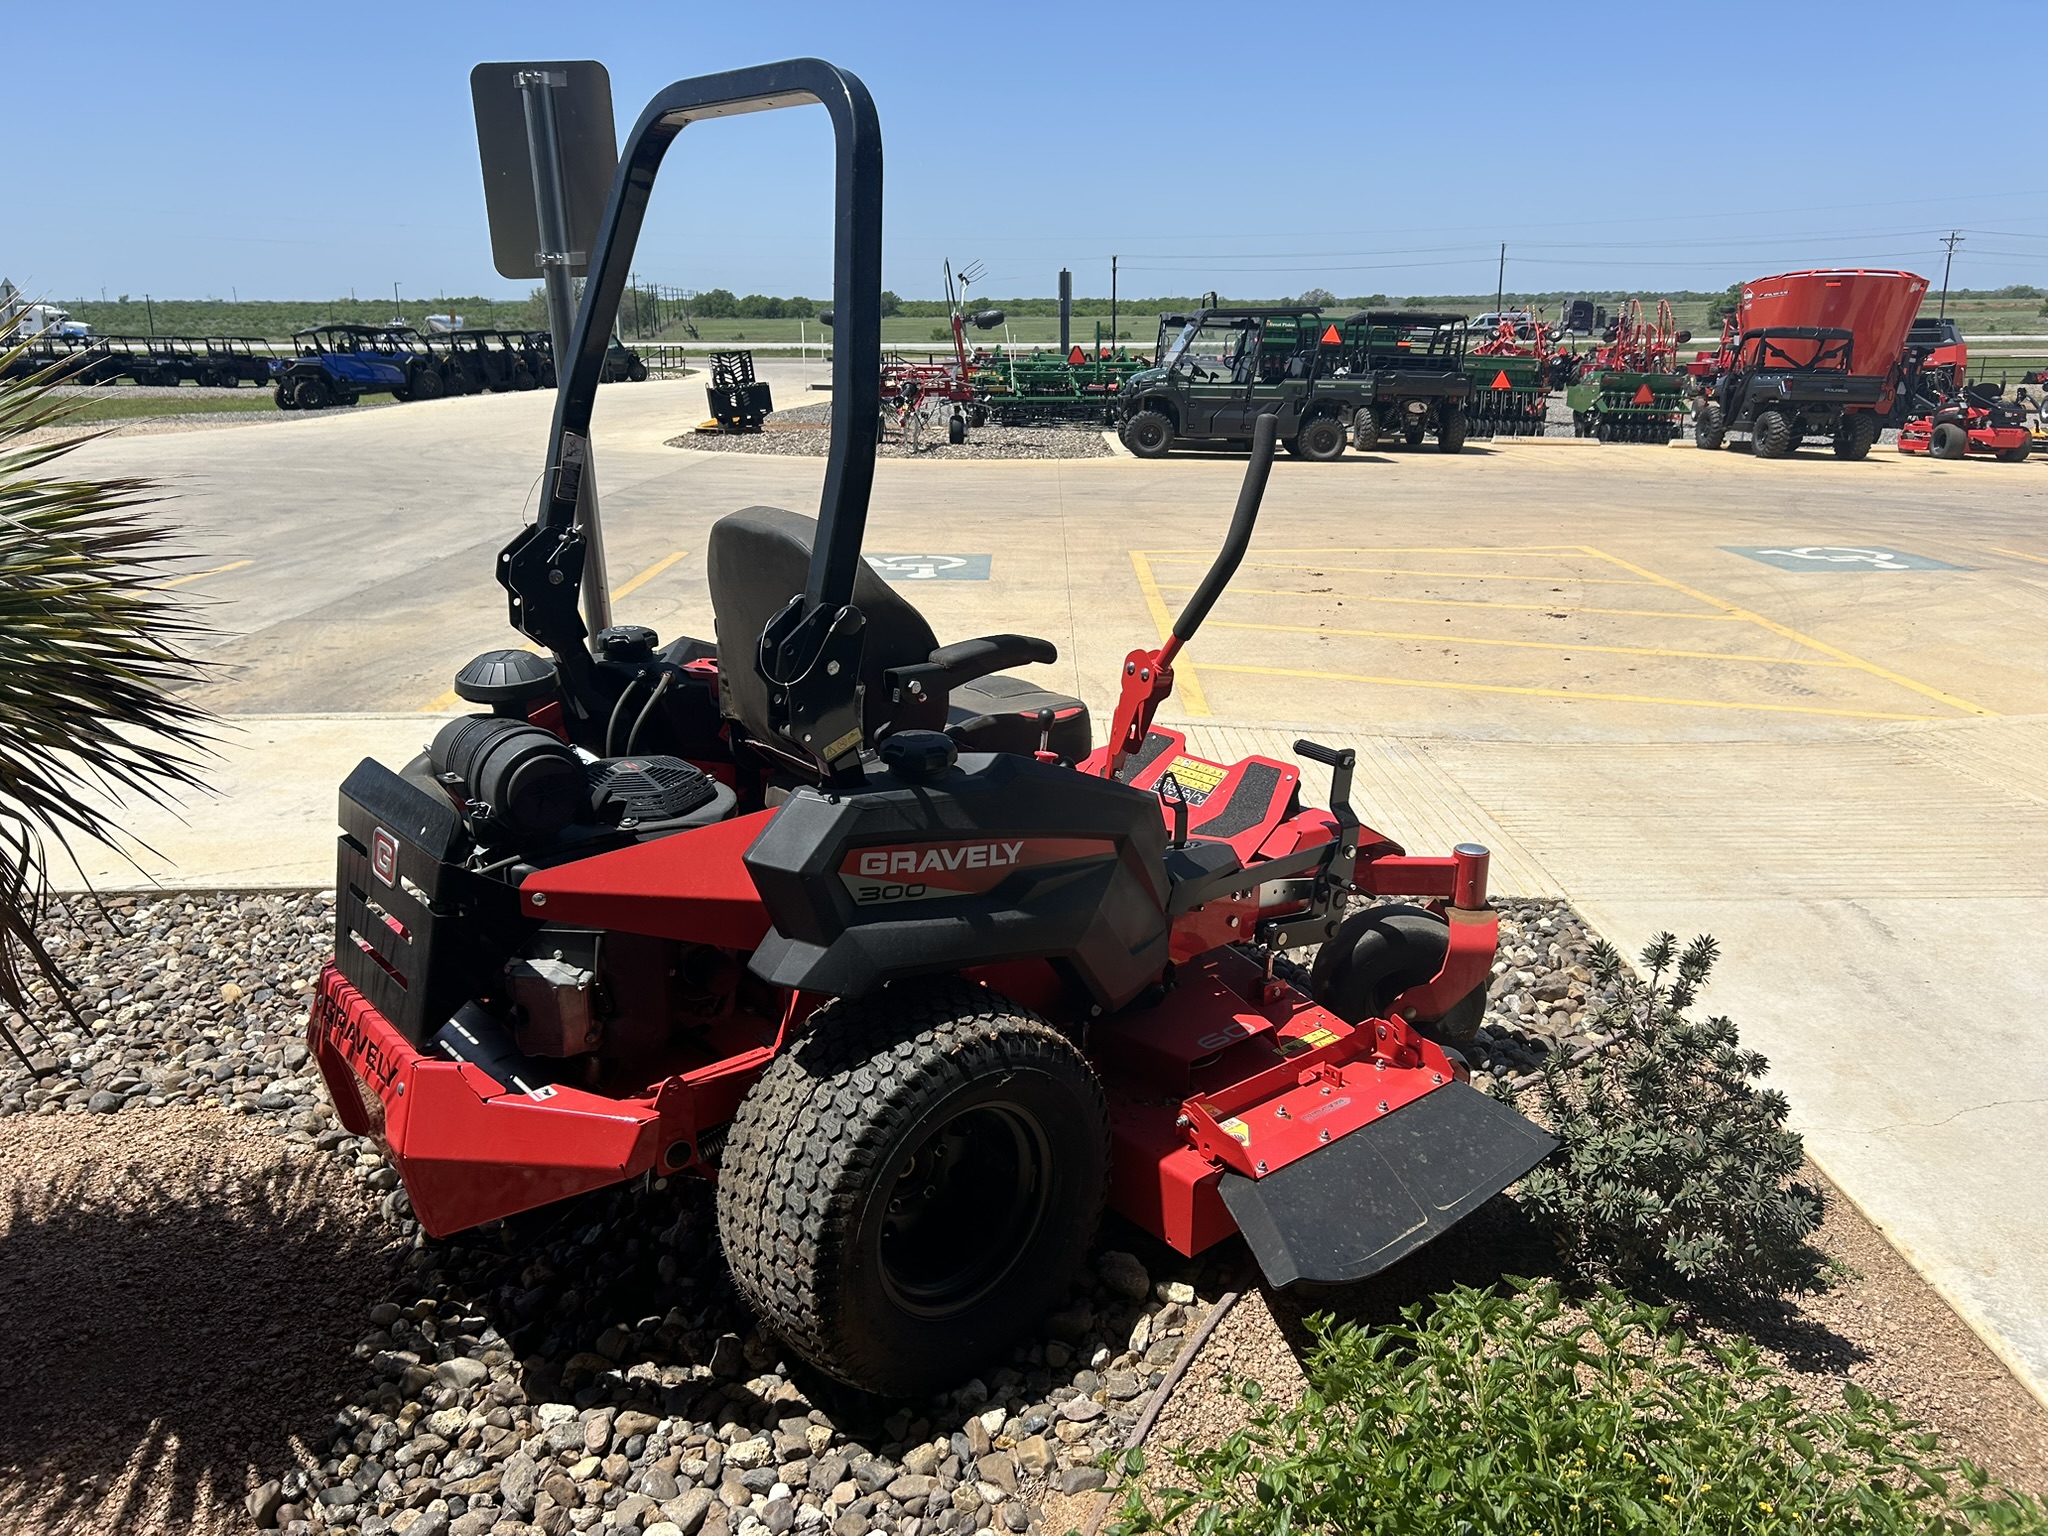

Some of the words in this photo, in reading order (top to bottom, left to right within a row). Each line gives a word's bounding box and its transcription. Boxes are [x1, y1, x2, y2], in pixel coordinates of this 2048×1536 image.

[859, 841, 1025, 875] GRAVELY
[857, 883, 927, 901] 300
[323, 993, 399, 1088] GRAVELY
[1197, 1022, 1256, 1049] 60
